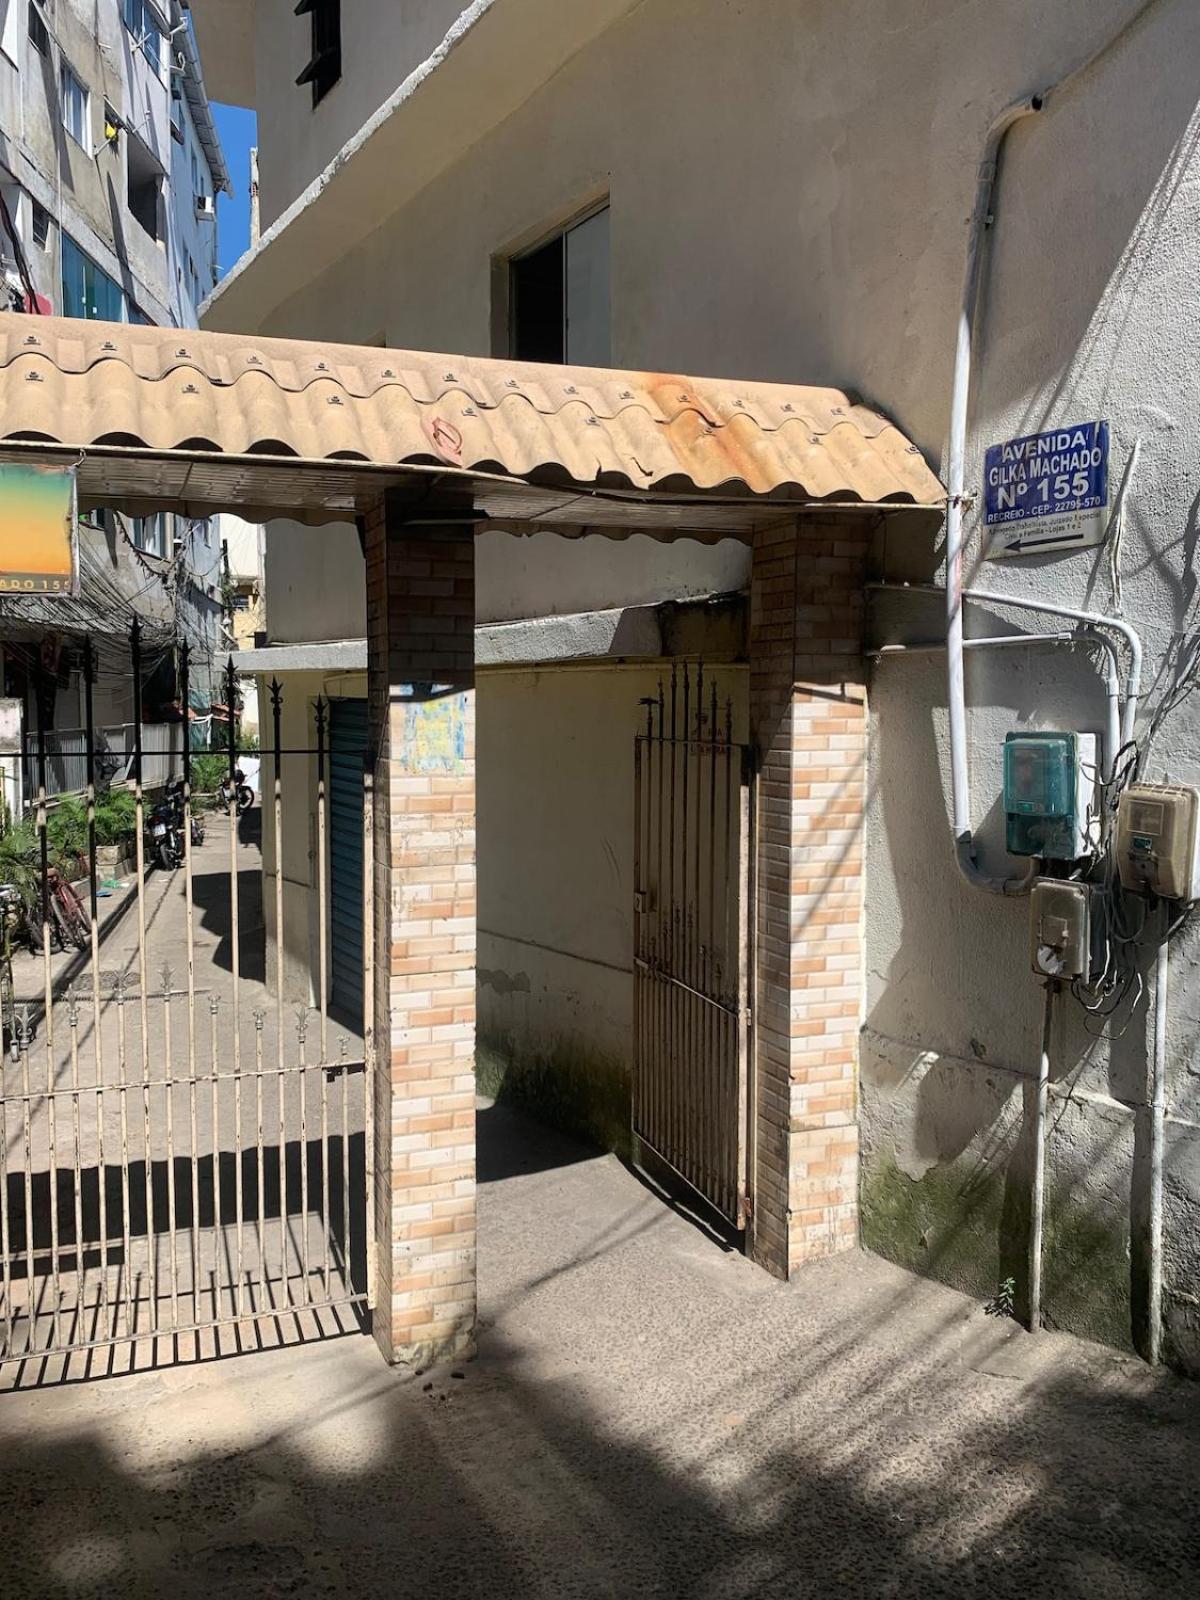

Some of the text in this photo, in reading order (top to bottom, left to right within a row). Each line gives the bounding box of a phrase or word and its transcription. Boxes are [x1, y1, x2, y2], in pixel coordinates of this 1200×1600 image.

[1002, 430, 1086, 462] AVENIDA
[989, 447, 1102, 487] GILKA MACHADO
[1037, 470, 1089, 502] 155
[988, 508, 1025, 523] RECREIO
[1031, 504, 1053, 516] CEP:
